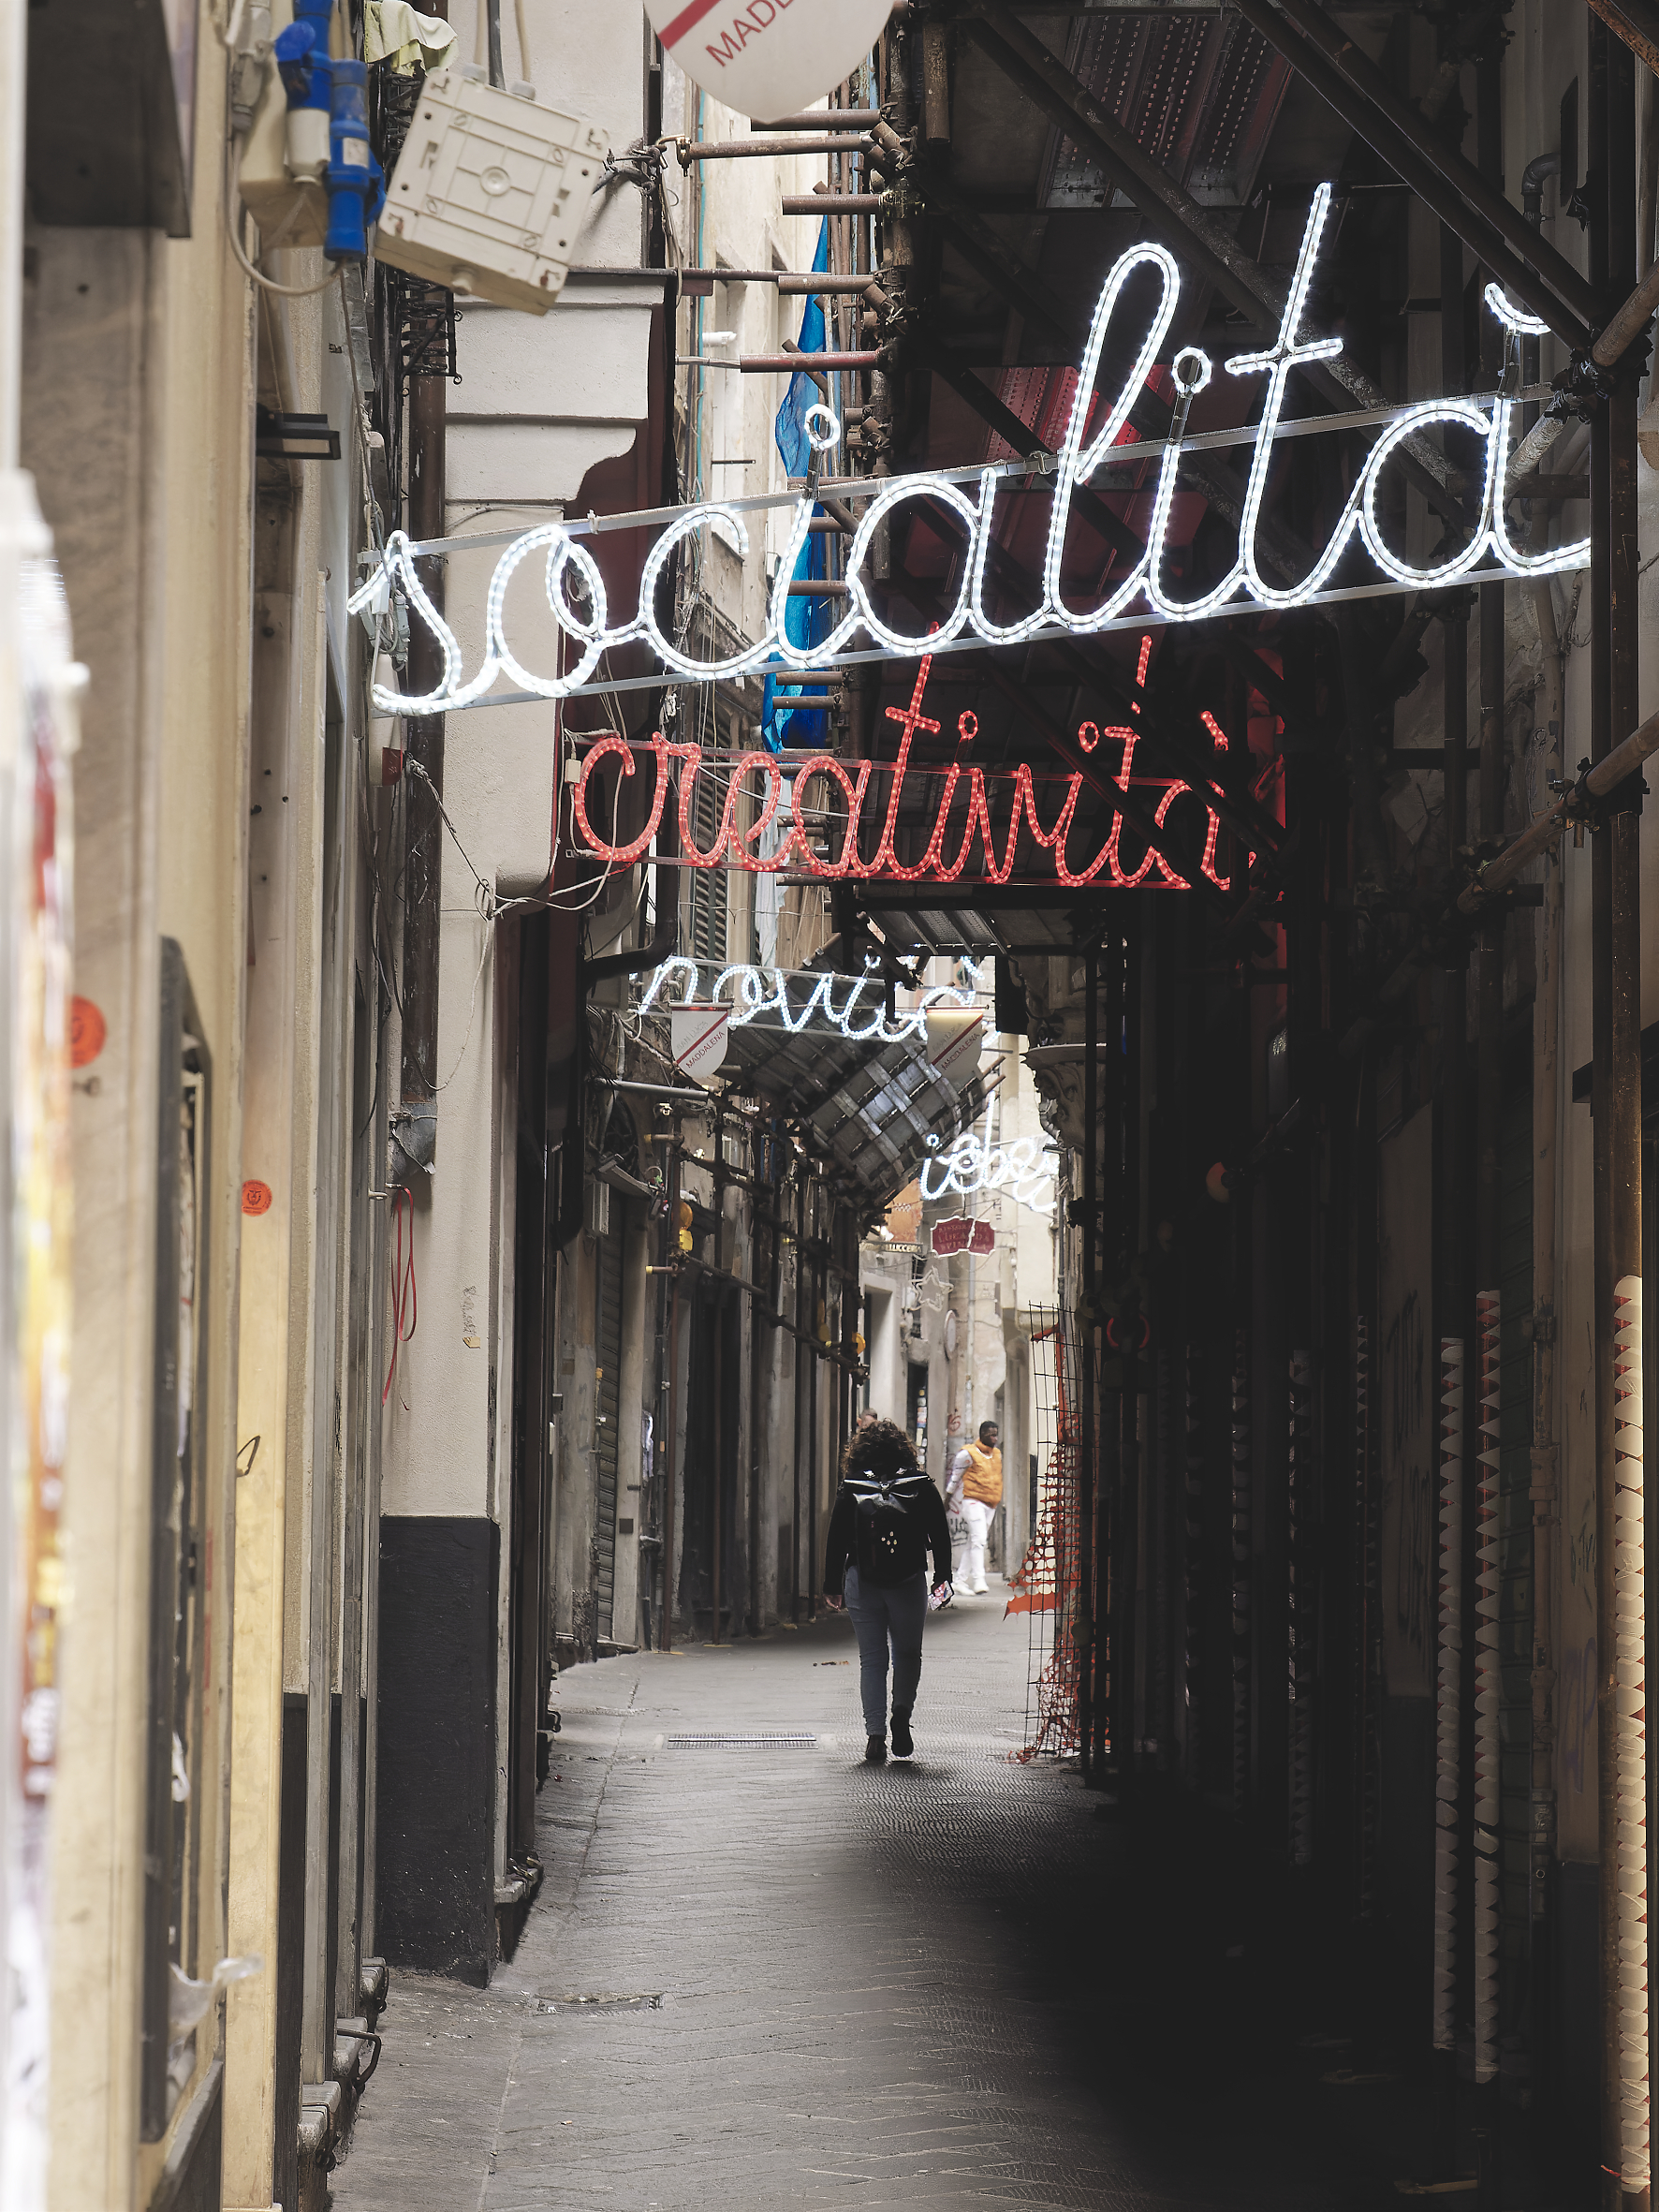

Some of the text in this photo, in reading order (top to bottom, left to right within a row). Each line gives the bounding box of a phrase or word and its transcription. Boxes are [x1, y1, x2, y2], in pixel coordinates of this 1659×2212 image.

[347, 182, 1591, 715] socialità
[574, 622, 1257, 891] creatività
[685, 1031, 725, 1069] MADDALENA
